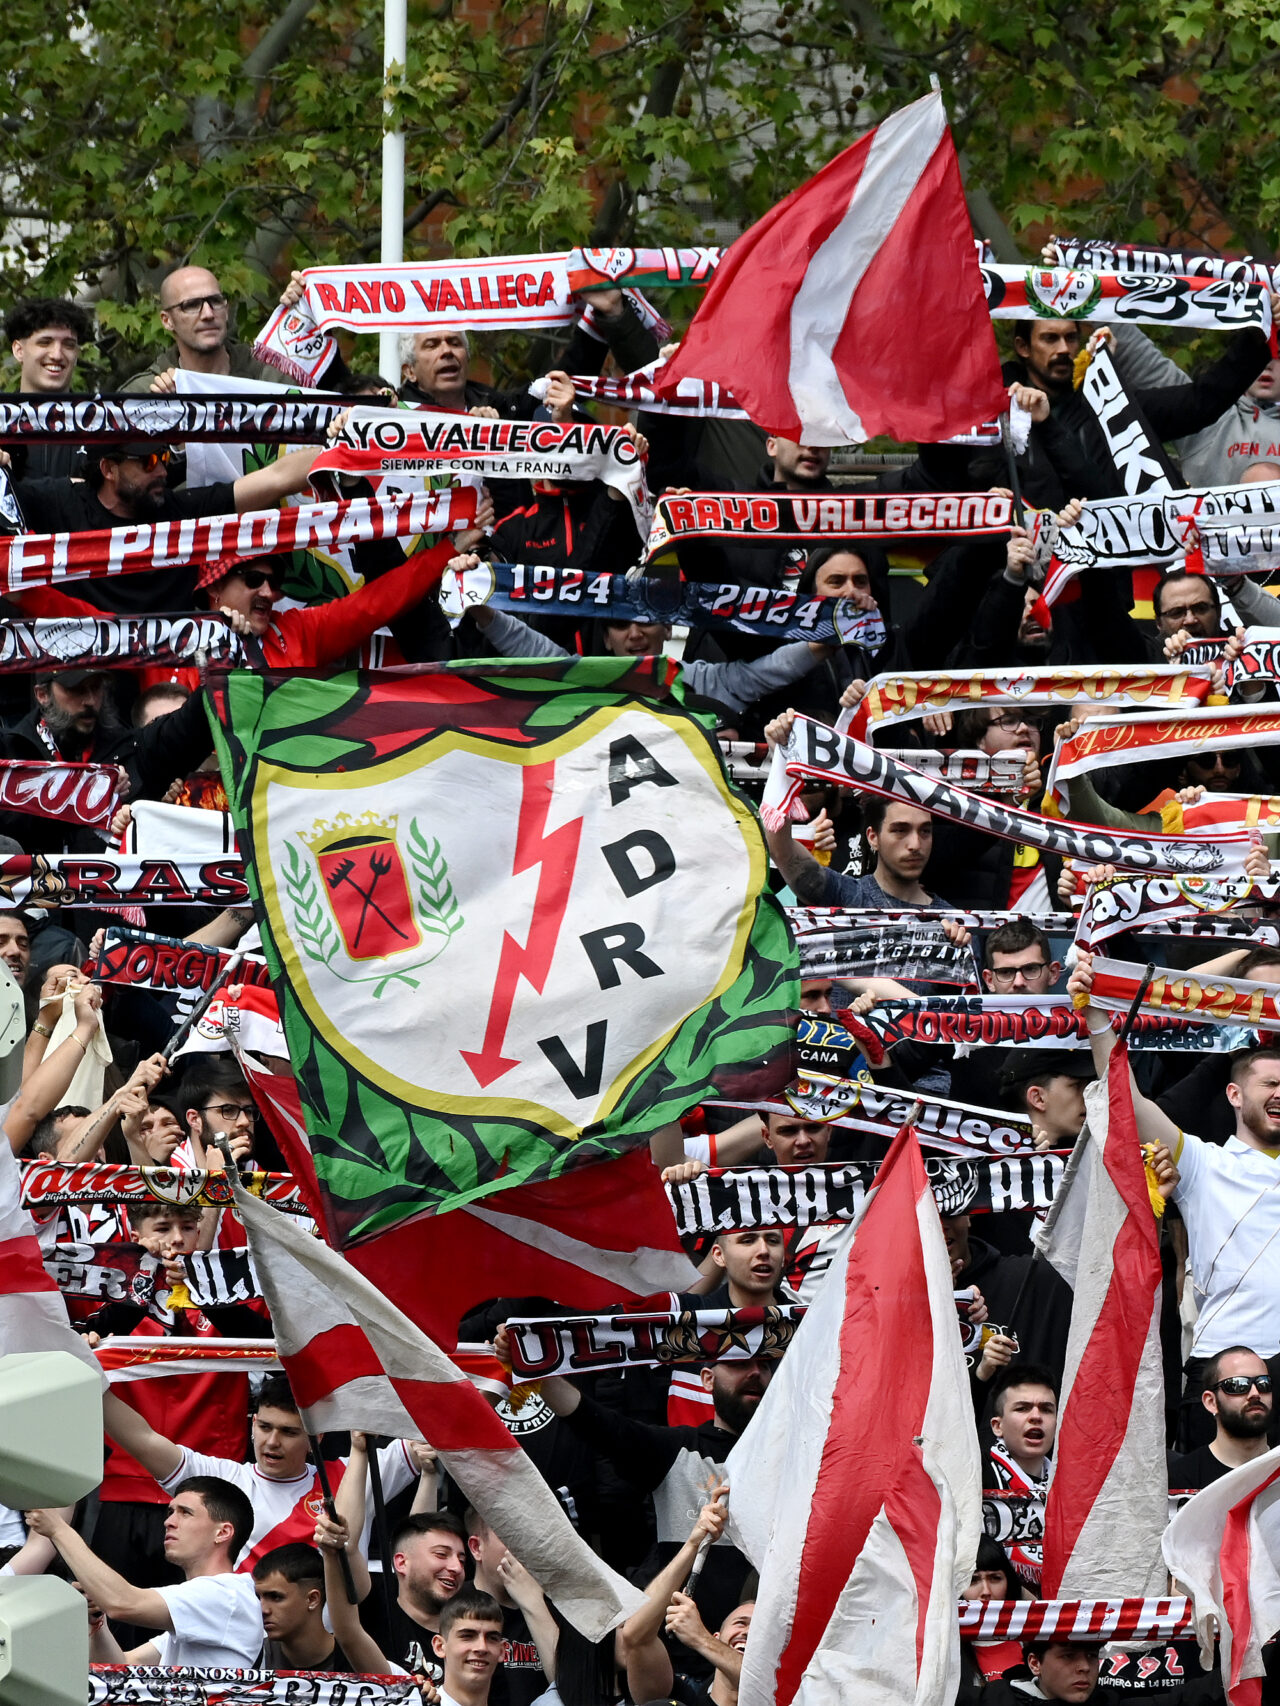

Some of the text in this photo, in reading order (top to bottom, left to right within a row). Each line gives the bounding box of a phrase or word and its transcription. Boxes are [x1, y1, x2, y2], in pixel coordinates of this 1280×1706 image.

[314, 281, 407, 314] RAYO
[381, 458, 573, 476] SIEMPRE CON LA FRANJA
[419, 421, 642, 467] VALLECANO
[1228, 441, 1260, 459] OPEN
[668, 496, 1014, 533] RAYO VALLECANO
[7, 531, 92, 593] EL
[105, 508, 283, 577] PUTO
[510, 564, 824, 629] 1924 2024
[866, 667, 1191, 724] 1924 2024
[1157, 715, 1230, 748] Rayo
[805, 721, 1158, 869] BUKANEROS
[1148, 974, 1268, 1024] 1924
[914, 1009, 1051, 1045] ORGULLO
[859, 1086, 1035, 1153] Vallec
[666, 1165, 866, 1236] ULTRAS
